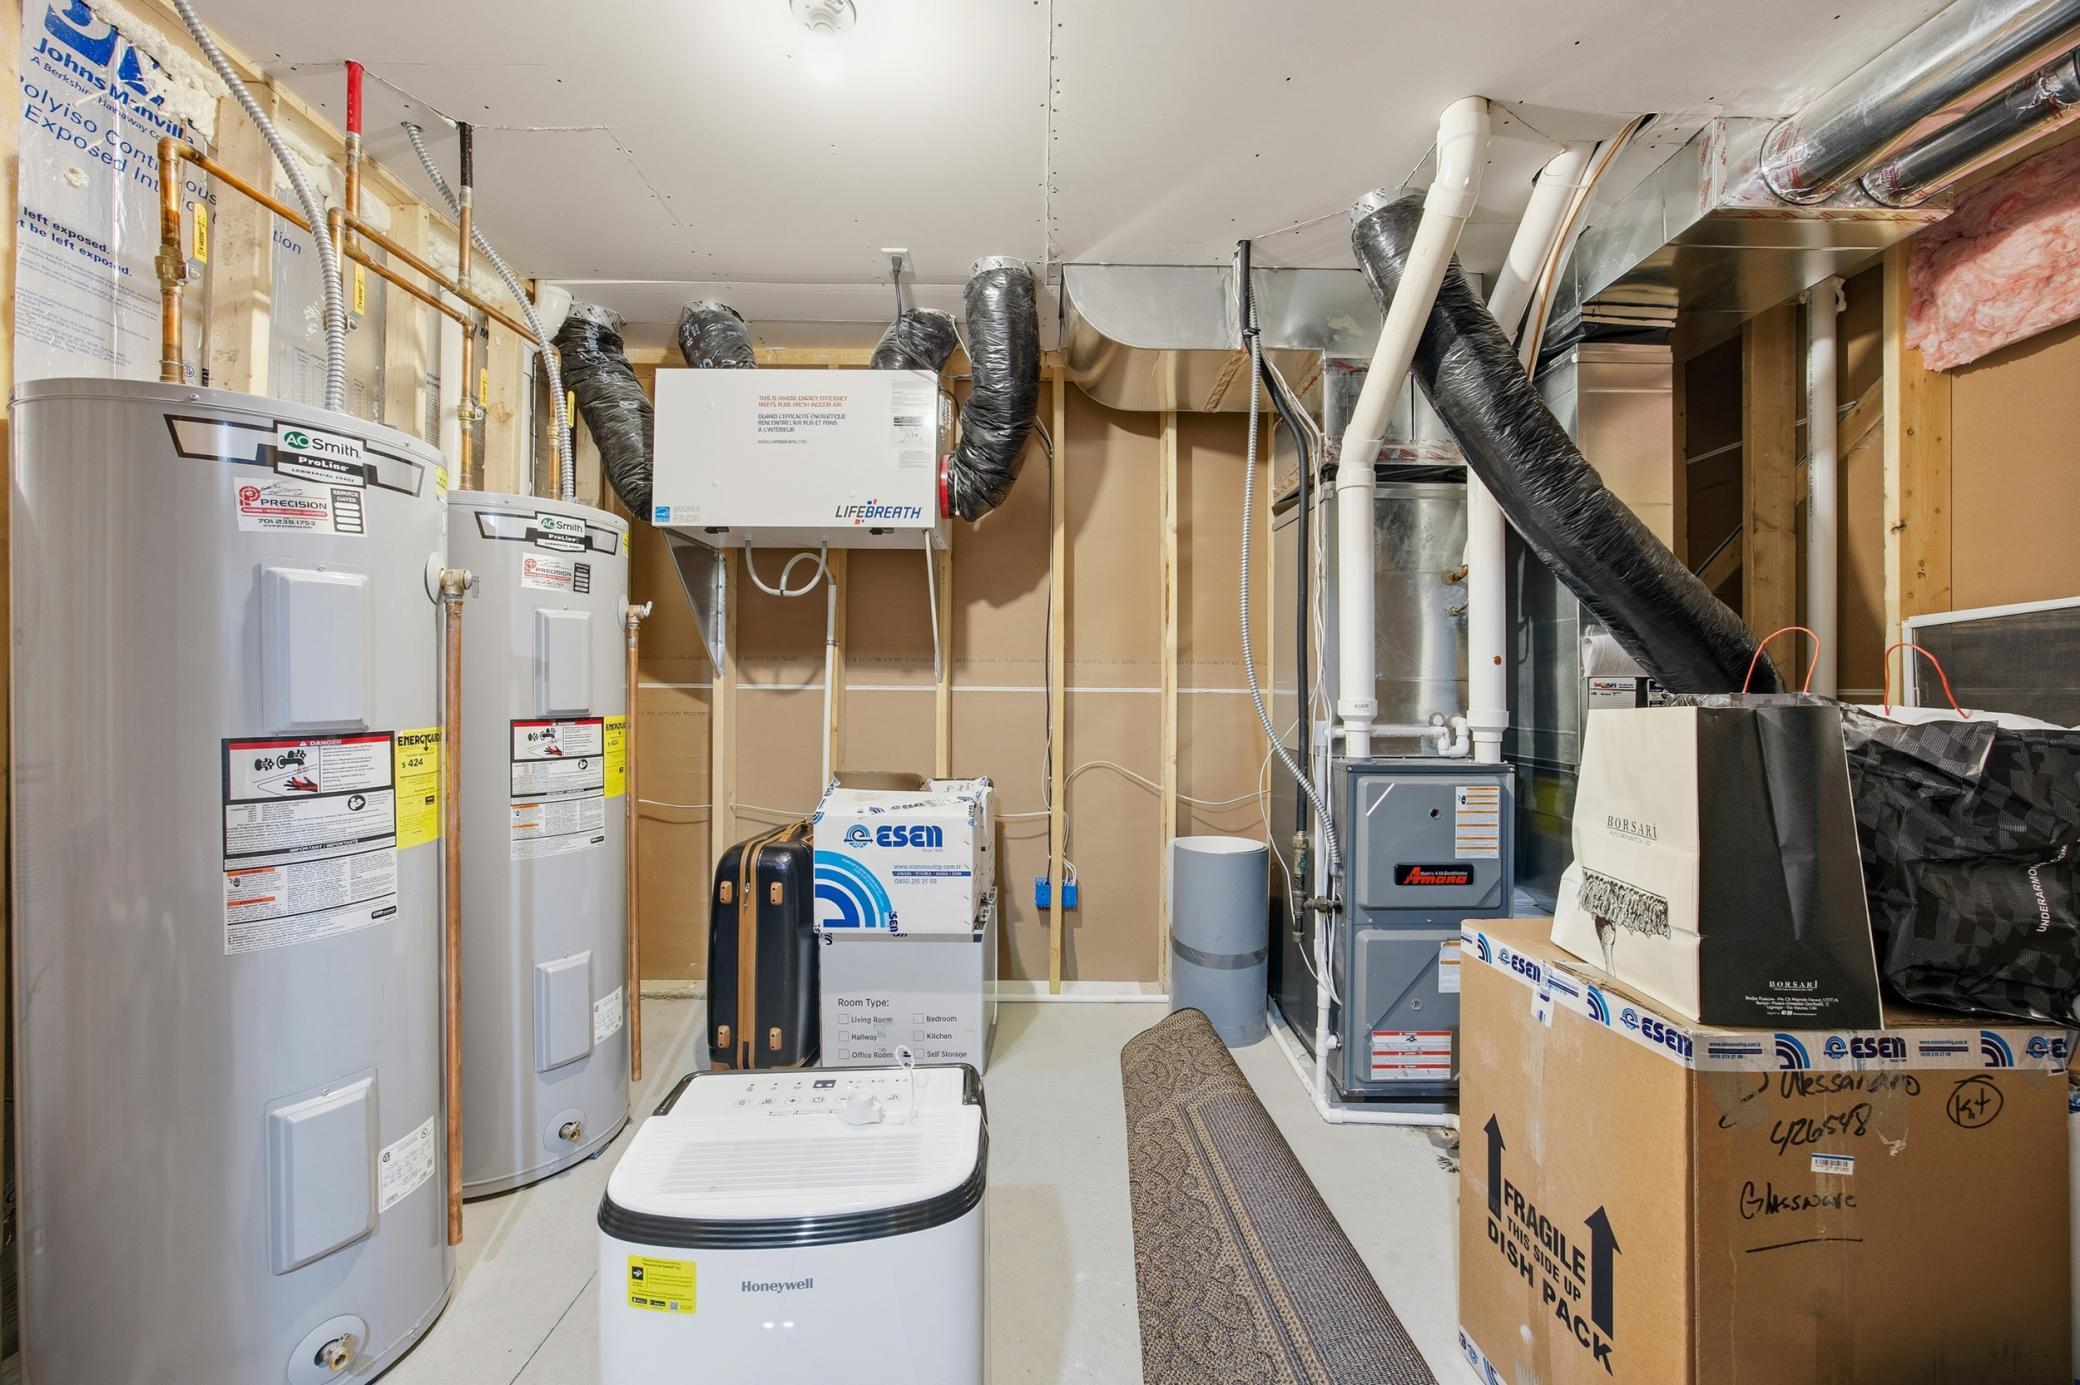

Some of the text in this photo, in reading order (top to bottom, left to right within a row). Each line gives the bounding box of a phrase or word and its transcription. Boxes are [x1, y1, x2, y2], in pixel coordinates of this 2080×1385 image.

[33, 37, 106, 91] Johns
[19, 74, 98, 134] olyiso
[43, 64, 93, 96] Berkshir
[97, 97, 148, 134] Haaway
[24, 104, 127, 173] Exposed
[23, 206, 110, 255] left exposed.
[30, 222, 48, 238] be
[51, 232, 75, 251] left
[79, 247, 133, 277] exposed.
[298, 456, 348, 472] ProLine
[260, 499, 328, 510] PRECISION
[835, 505, 922, 519] LIFEBREATH
[556, 521, 583, 533] Smith
[309, 739, 342, 747] DANGER
[407, 757, 424, 768] 424
[1403, 866, 1467, 885] Amana
[838, 998, 890, 1008] Room Type:
[851, 1015, 893, 1024] Living Room
[926, 1014, 957, 1023] Bedroom
[851, 1033, 877, 1041] Hallway
[926, 1032, 952, 1040] Kitchen
[851, 1050, 893, 1059] Office Room
[926, 1050, 967, 1059] Self Storage
[1504, 1178, 1586, 1286] FRAGILE
[1507, 1215, 1582, 1303] THIS SIDE UP
[740, 1278, 814, 1294] Honeywell
[1488, 1215, 1614, 1377] DISH PACK
